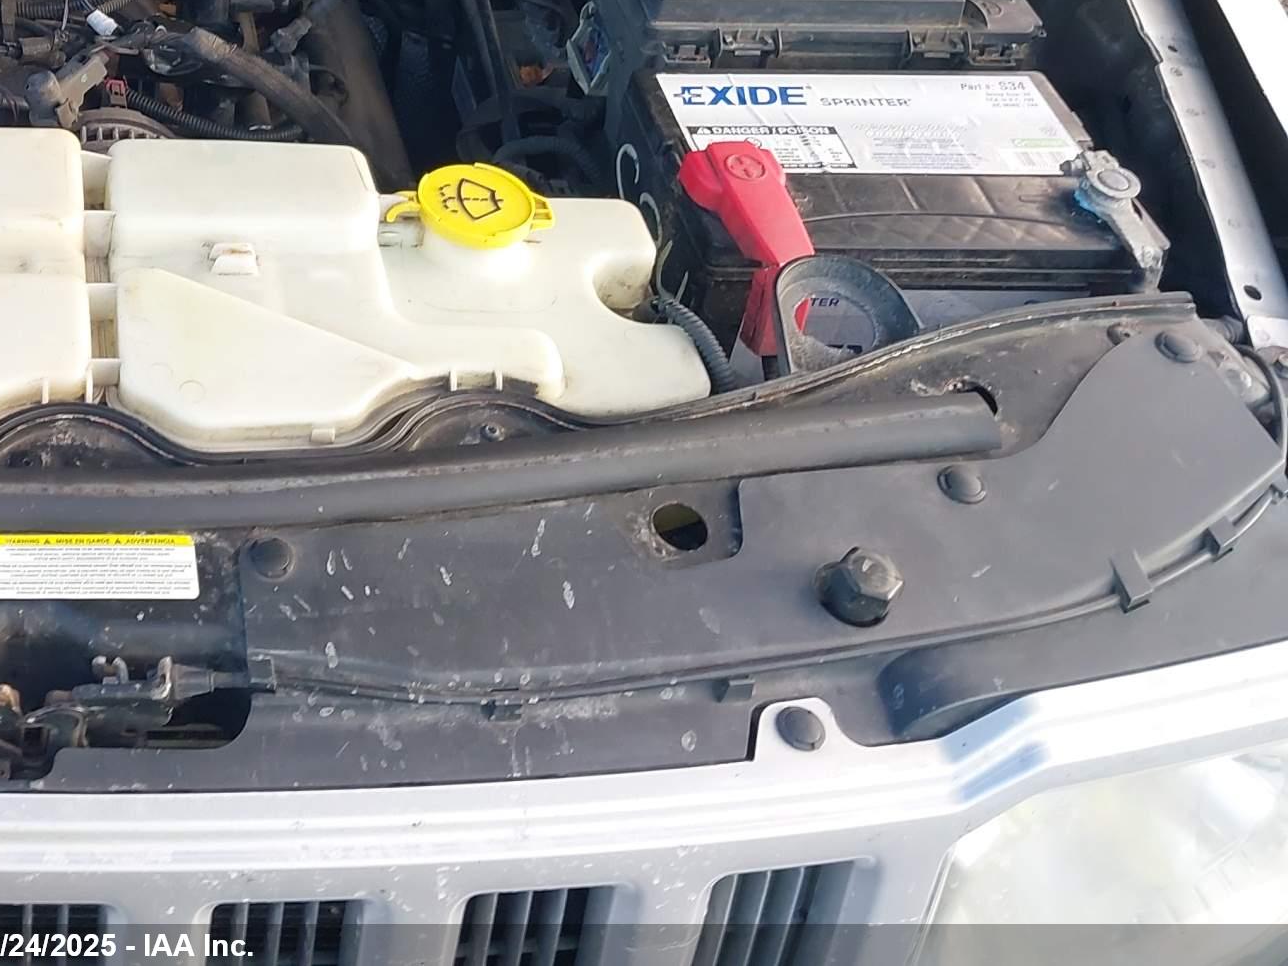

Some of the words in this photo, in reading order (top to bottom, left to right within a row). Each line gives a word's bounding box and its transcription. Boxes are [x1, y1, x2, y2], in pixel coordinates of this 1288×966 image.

[998, 81, 1026, 91] S34
[678, 85, 807, 106] EXIDE
[819, 97, 909, 108] SPRINTER
[711, 126, 770, 135] DANGER
[778, 126, 830, 135] POISON
